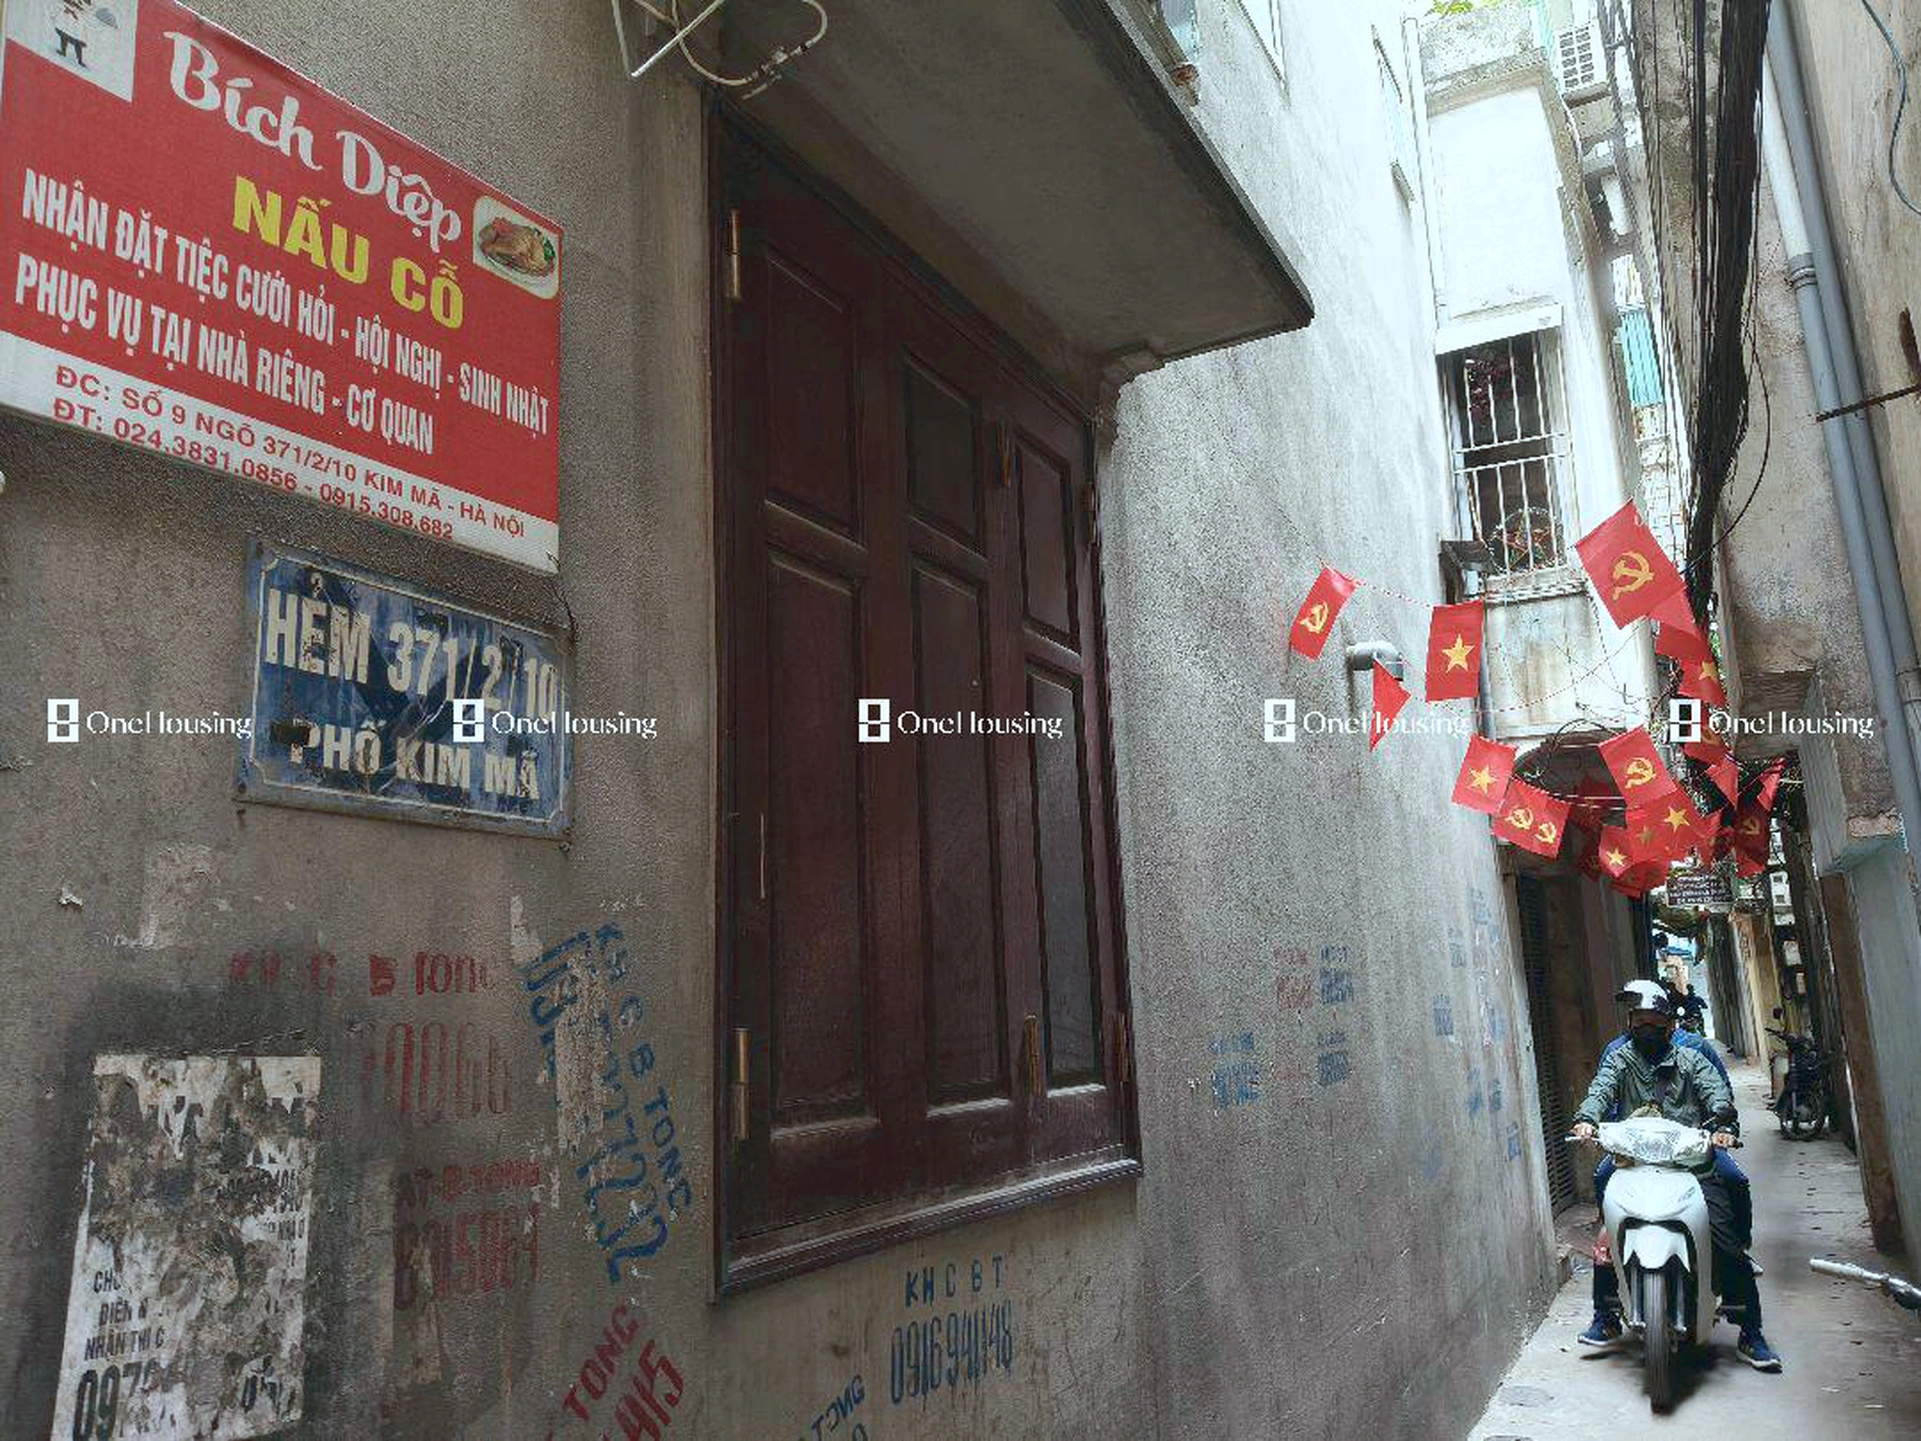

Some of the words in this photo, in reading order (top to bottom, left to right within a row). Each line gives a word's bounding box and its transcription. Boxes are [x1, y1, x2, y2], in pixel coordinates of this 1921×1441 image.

[163, 31, 323, 171] Bích
[335, 130, 462, 253] Diệp
[22, 167, 109, 252] NHẬN
[115, 208, 168, 279] ĐẶT
[175, 236, 228, 304] TIỆC
[236, 264, 291, 328] CƯỚI
[297, 285, 335, 346] HỎI
[355, 314, 390, 375] HỘI
[395, 333, 441, 400] NGHỊ
[459, 362, 500, 416] SINH
[232, 175, 370, 285] NẤU
[391, 257, 464, 329] CỖ
[15, 252, 98, 334] PHỤC
[107, 287, 143, 357] VỤ
[150, 304, 191, 371] TẠI
[197, 324, 249, 387] NHÀ
[255, 347, 325, 416] RIÊNG
[346, 383, 377, 432] CƠ
[380, 397, 434, 455] QUAN
[53, 398, 102, 432] ĐT:
[113, 418, 298, 491] 024.3831.0856
[319, 483, 453, 540] 0915.308.682
[56, 364, 110, 400] ĐC:
[122, 387, 163, 417] SỐ
[172, 405, 186, 425] 9
[195, 412, 255, 448] NGÕ
[263, 435, 356, 482] 371/2/10
[364, 468, 403, 497] KIM
[411, 485, 442, 511] MÃ
[460, 500, 487, 526] HÀ
[494, 512, 524, 538] NỘI
[396, 737, 471, 789] KIM
[484, 749, 540, 800] MÃ
